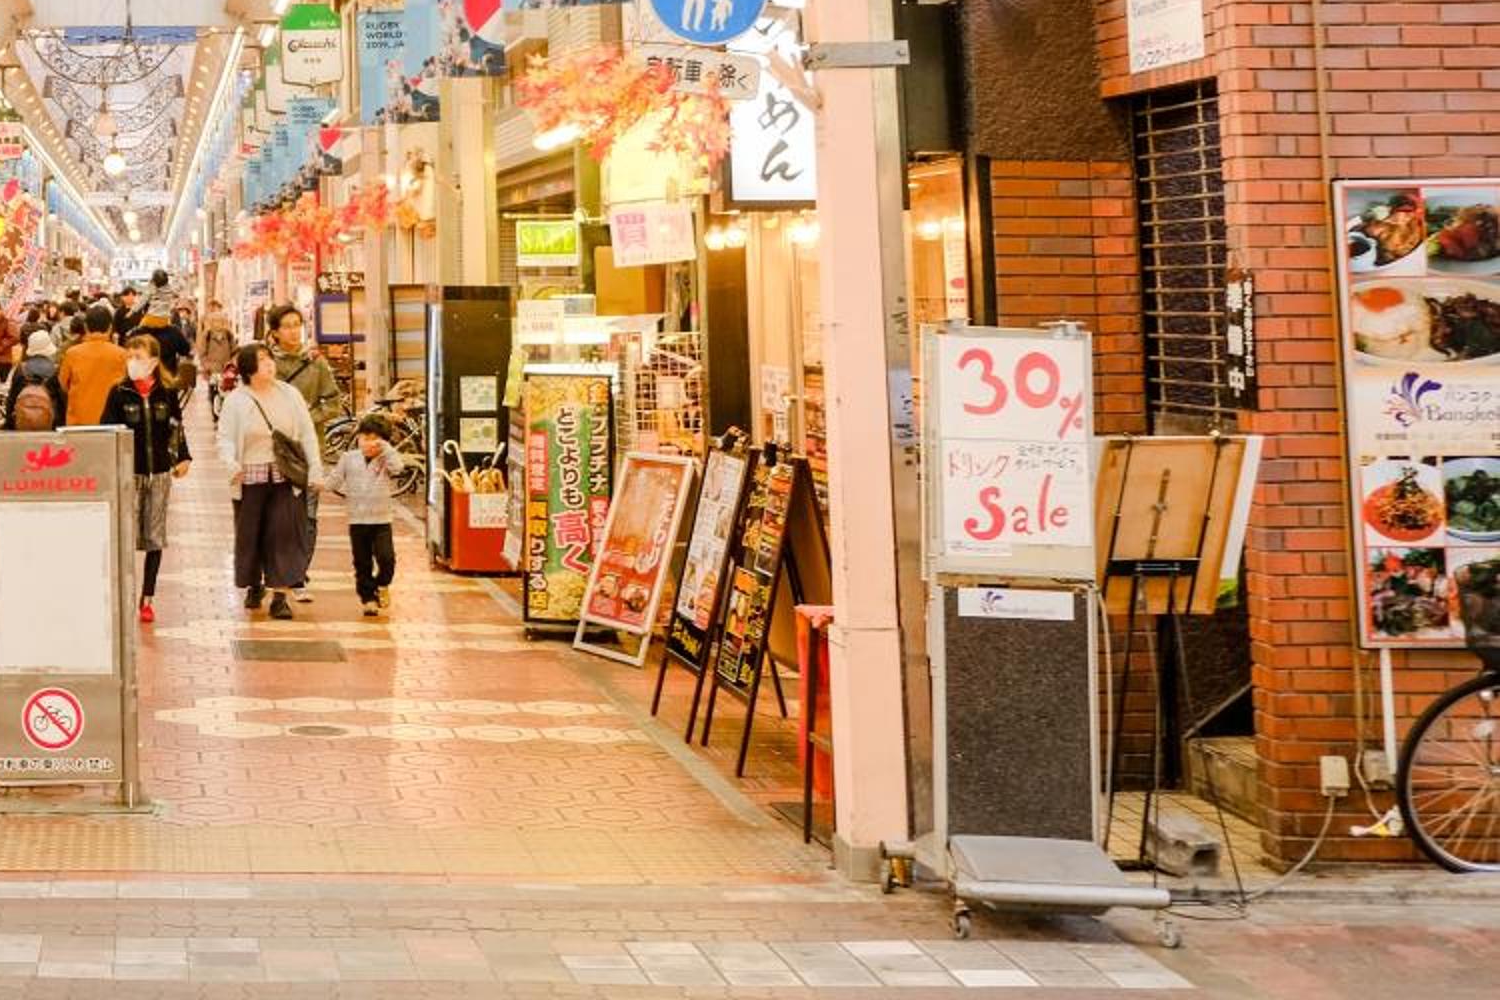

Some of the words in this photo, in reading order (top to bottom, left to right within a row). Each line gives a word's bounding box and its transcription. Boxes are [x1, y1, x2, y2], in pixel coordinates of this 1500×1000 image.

[958, 348, 1084, 440] 30%
[949, 450, 1010, 478] ドリンク
[964, 474, 1069, 541] Sale
